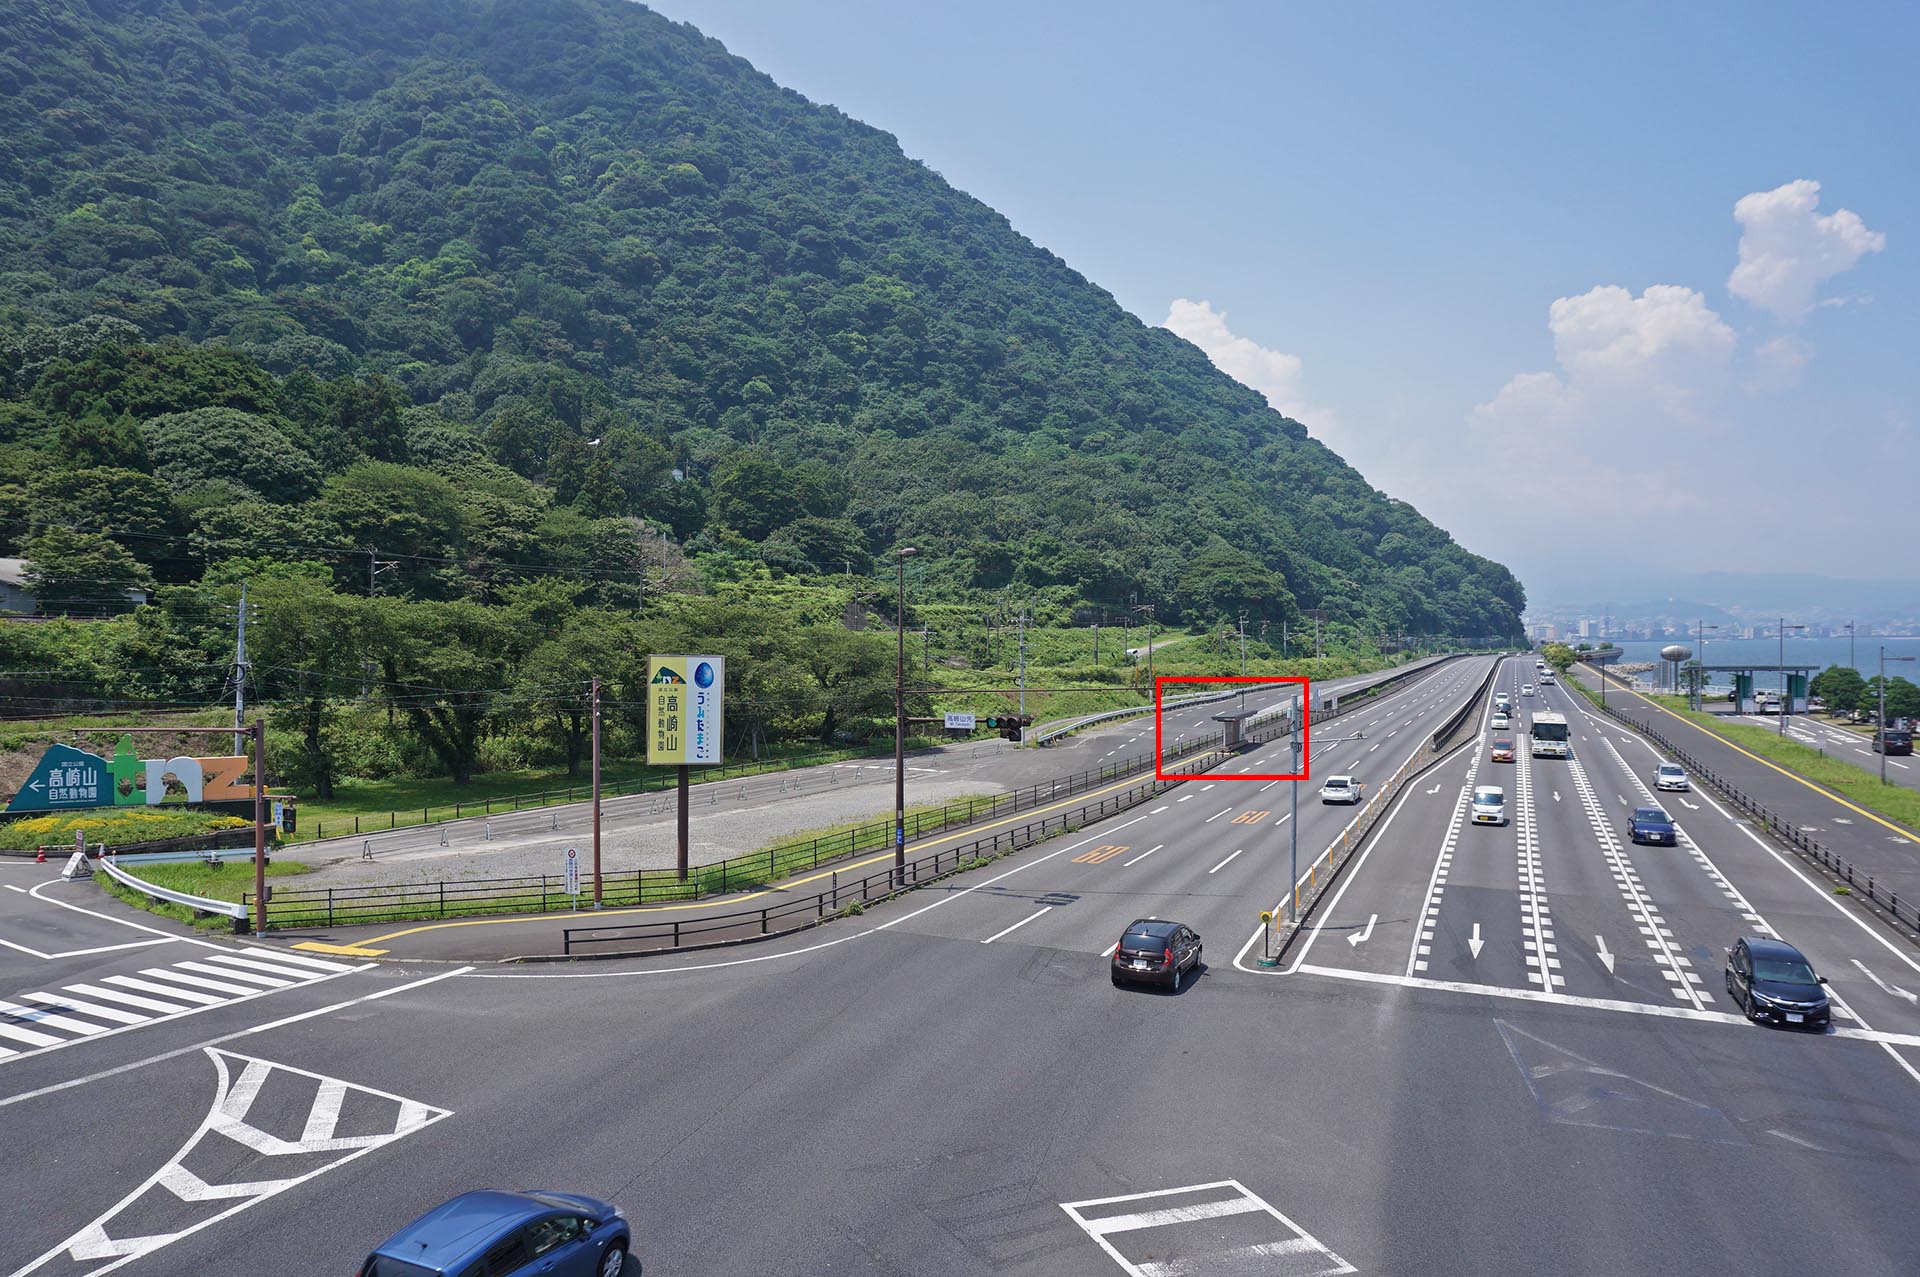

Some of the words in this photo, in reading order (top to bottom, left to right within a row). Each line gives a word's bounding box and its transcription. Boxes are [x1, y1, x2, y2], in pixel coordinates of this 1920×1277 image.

[667, 695, 678, 751] 高崎山
[696, 692, 704, 758] うみたまご
[49, 767, 97, 787] 高崎山
[49, 787, 97, 800] 自然動物園
[1231, 810, 1271, 824] 60
[1072, 845, 1130, 864] 60
